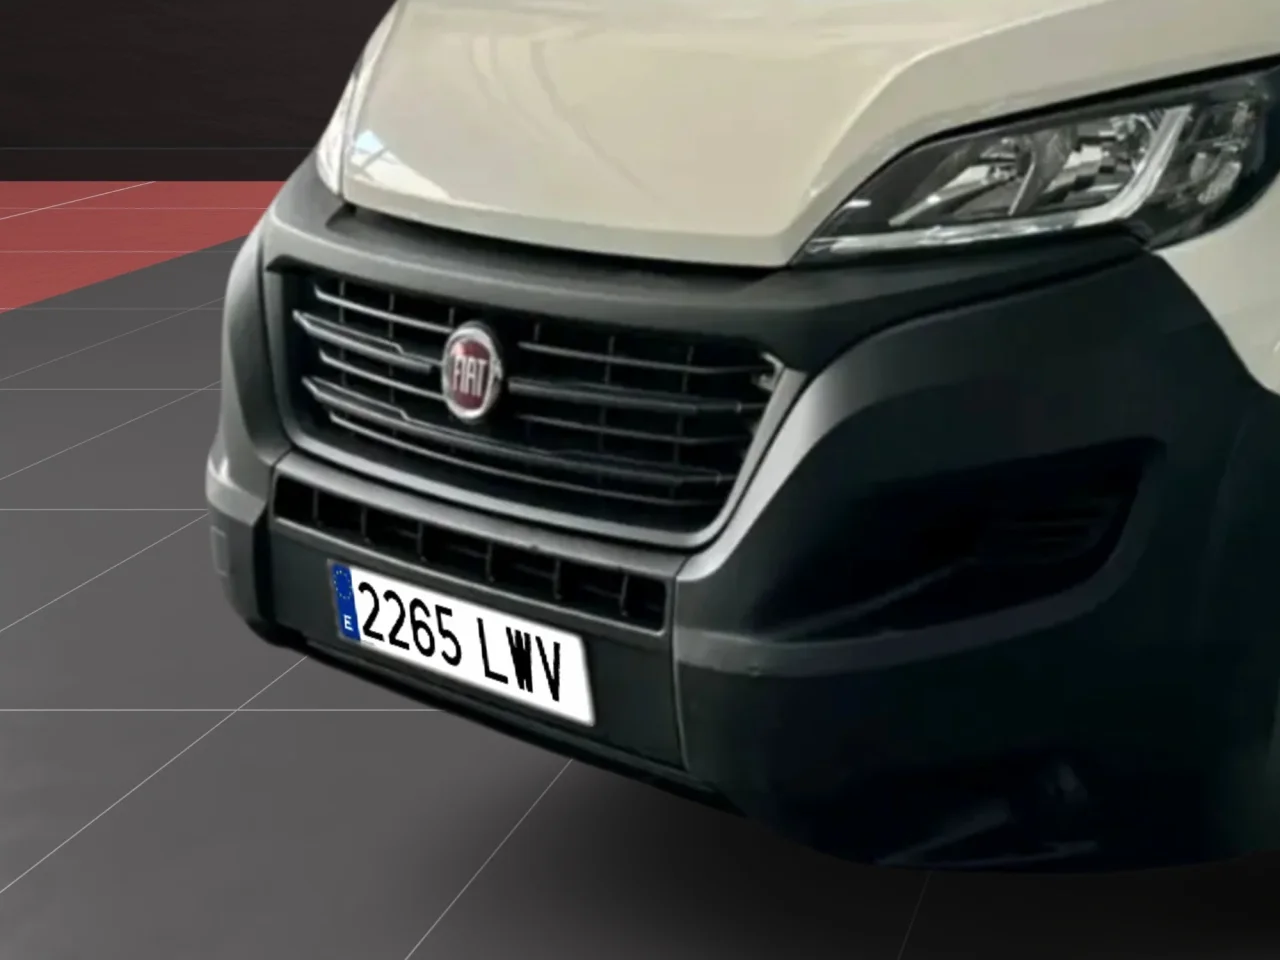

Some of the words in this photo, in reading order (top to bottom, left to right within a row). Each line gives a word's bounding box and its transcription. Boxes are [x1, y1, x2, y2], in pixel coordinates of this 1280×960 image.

[452, 354, 487, 398] FIAT
[344, 615, 353, 631] E
[358, 581, 462, 667] 2265
[477, 617, 560, 702] LWV
